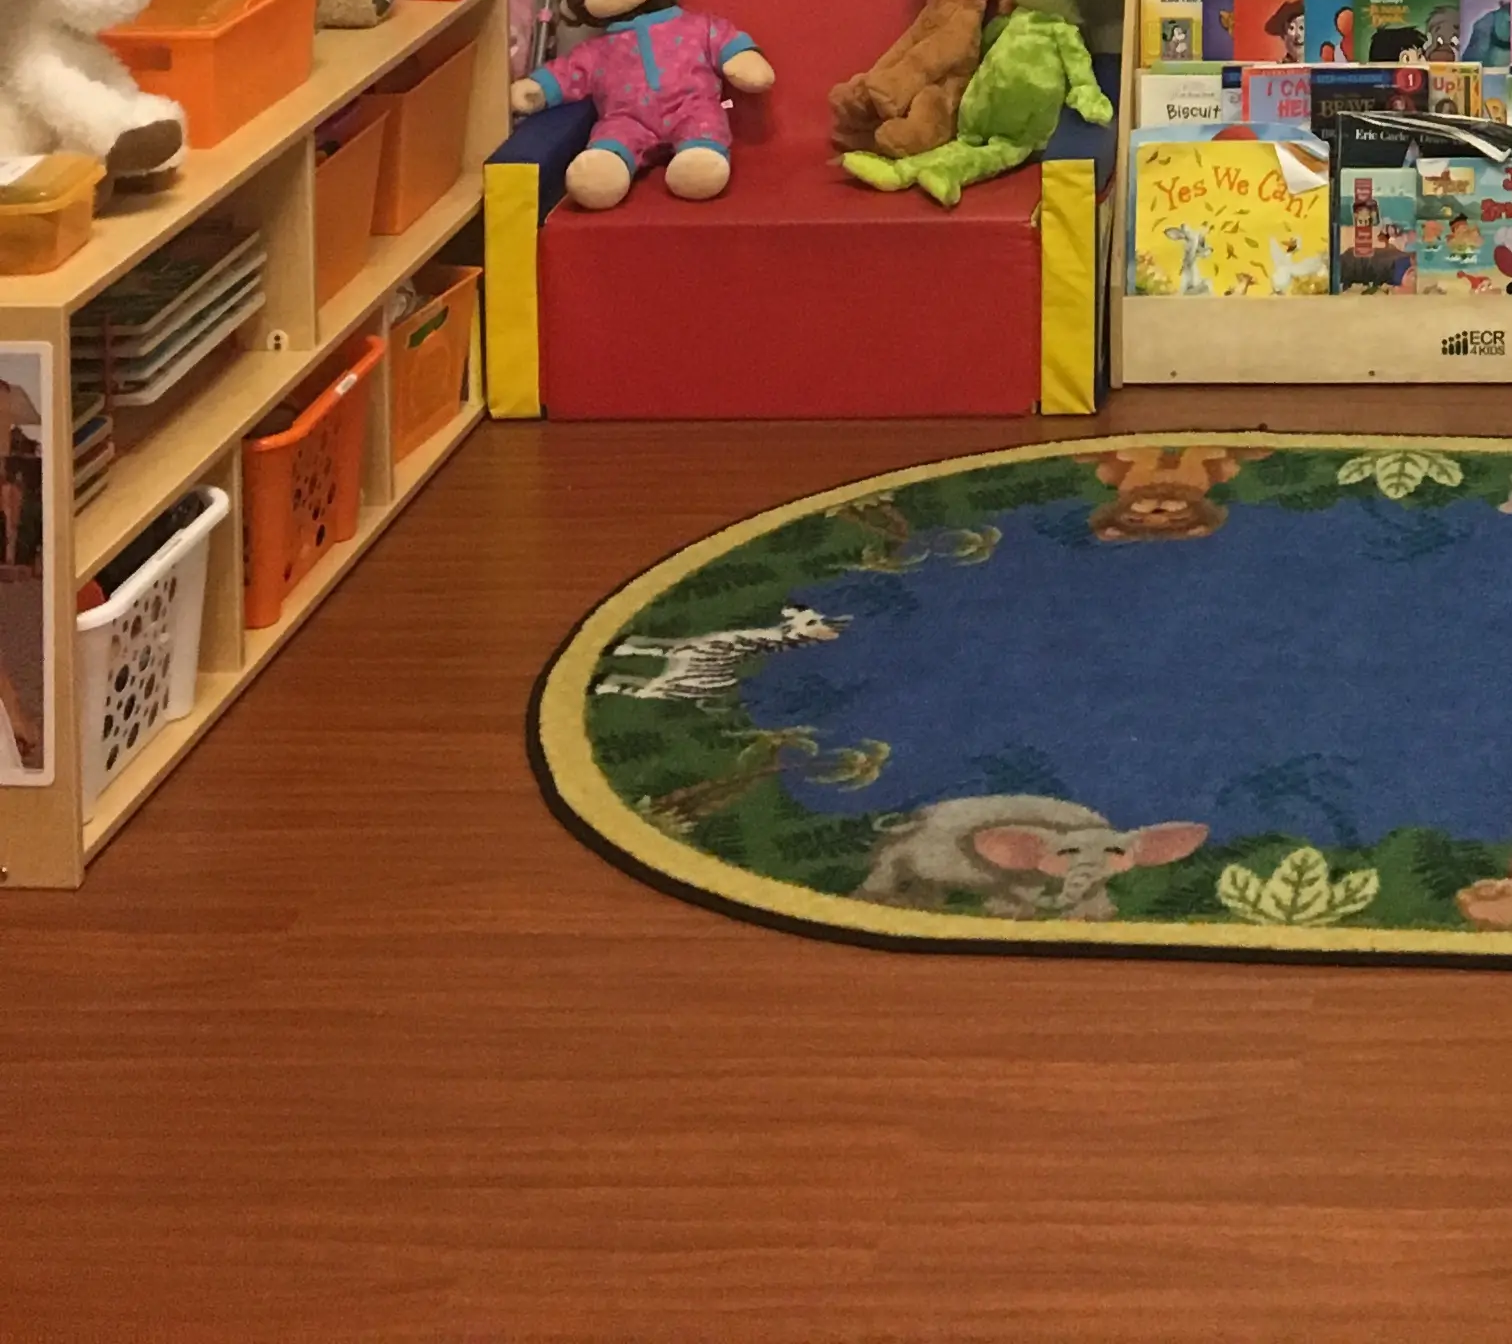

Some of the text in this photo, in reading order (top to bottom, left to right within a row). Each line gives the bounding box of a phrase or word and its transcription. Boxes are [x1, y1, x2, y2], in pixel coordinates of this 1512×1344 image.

[1433, 77, 1461, 93] Up!
[1166, 105, 1221, 120] Biscuit
[1356, 129, 1377, 140] Eric
[1155, 167, 1319, 219] Yes We Can!
[1470, 331, 1505, 345] ECR
[1470, 345, 1505, 355] 4 KIDS
